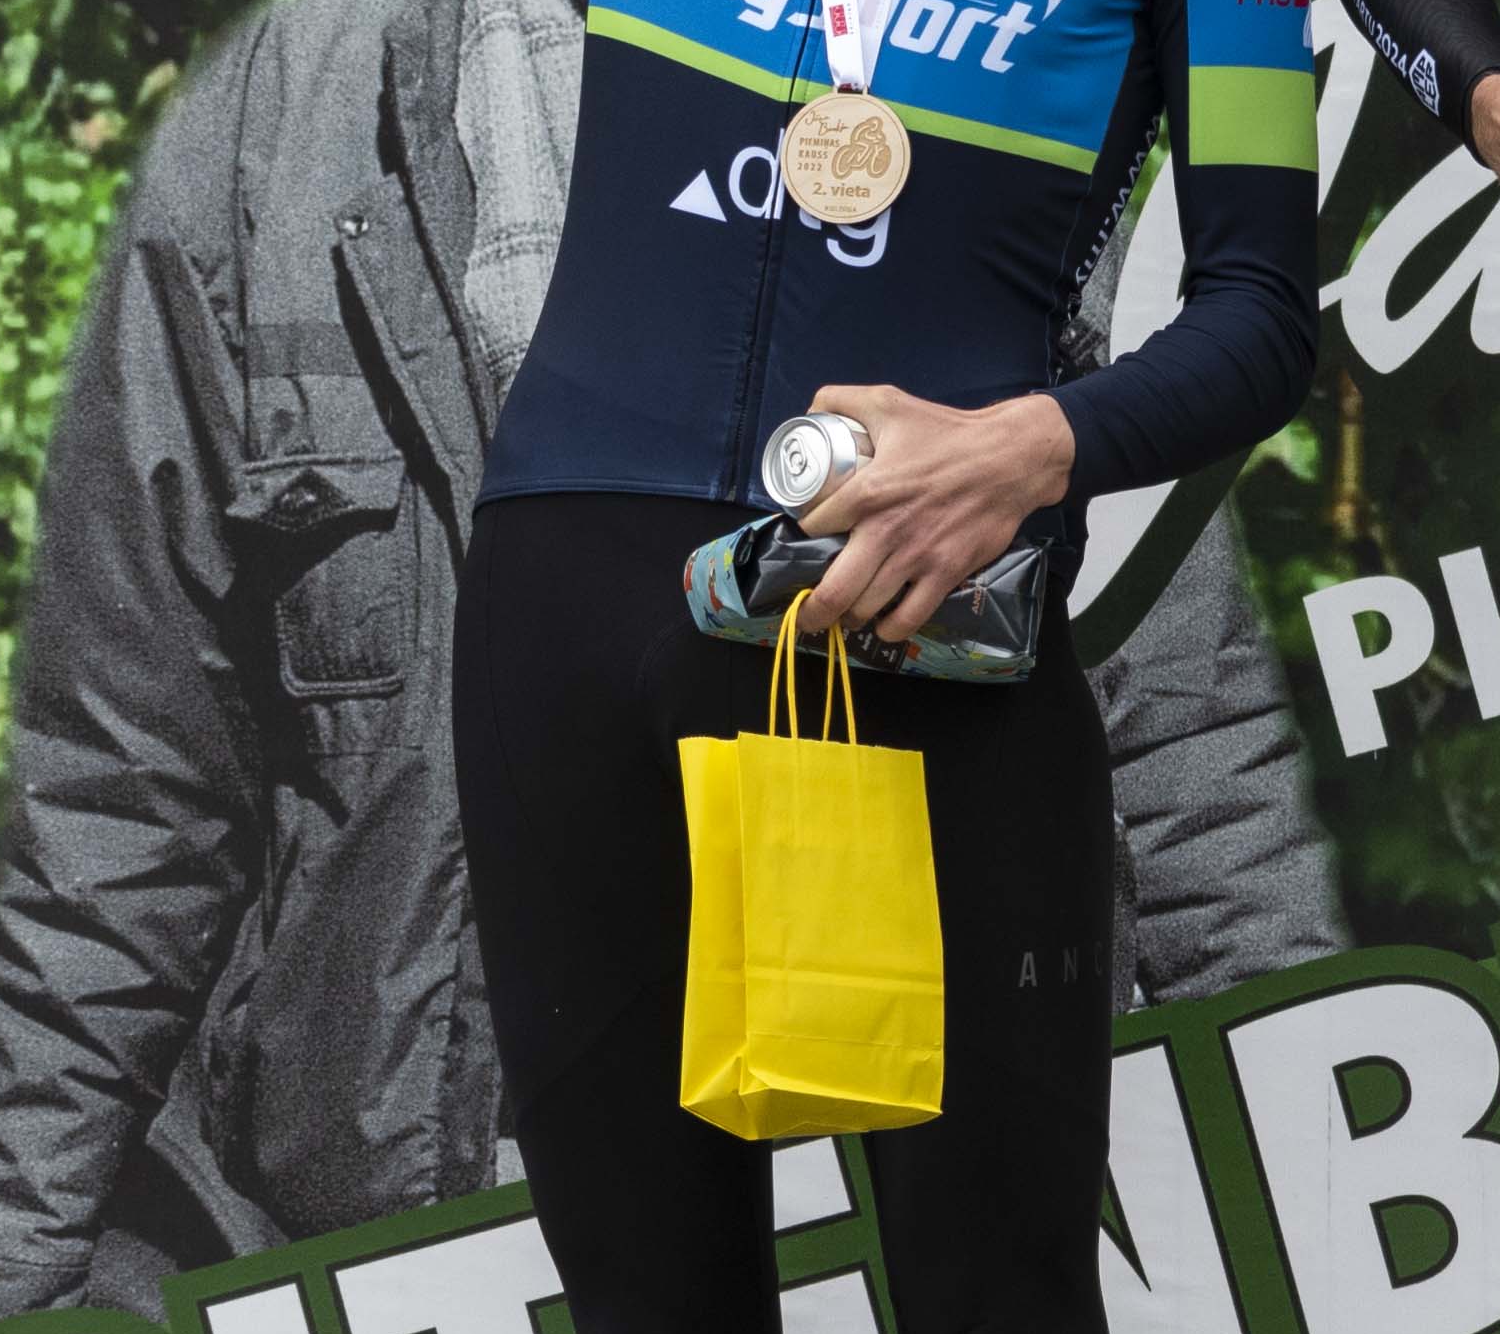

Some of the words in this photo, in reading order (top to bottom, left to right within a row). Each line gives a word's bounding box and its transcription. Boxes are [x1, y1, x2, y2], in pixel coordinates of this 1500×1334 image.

[1375, 22, 1411, 79] 2024
[796, 162, 823, 172] 2022
[812, 182, 828, 196] 2.
[830, 182, 871, 198] vieta
